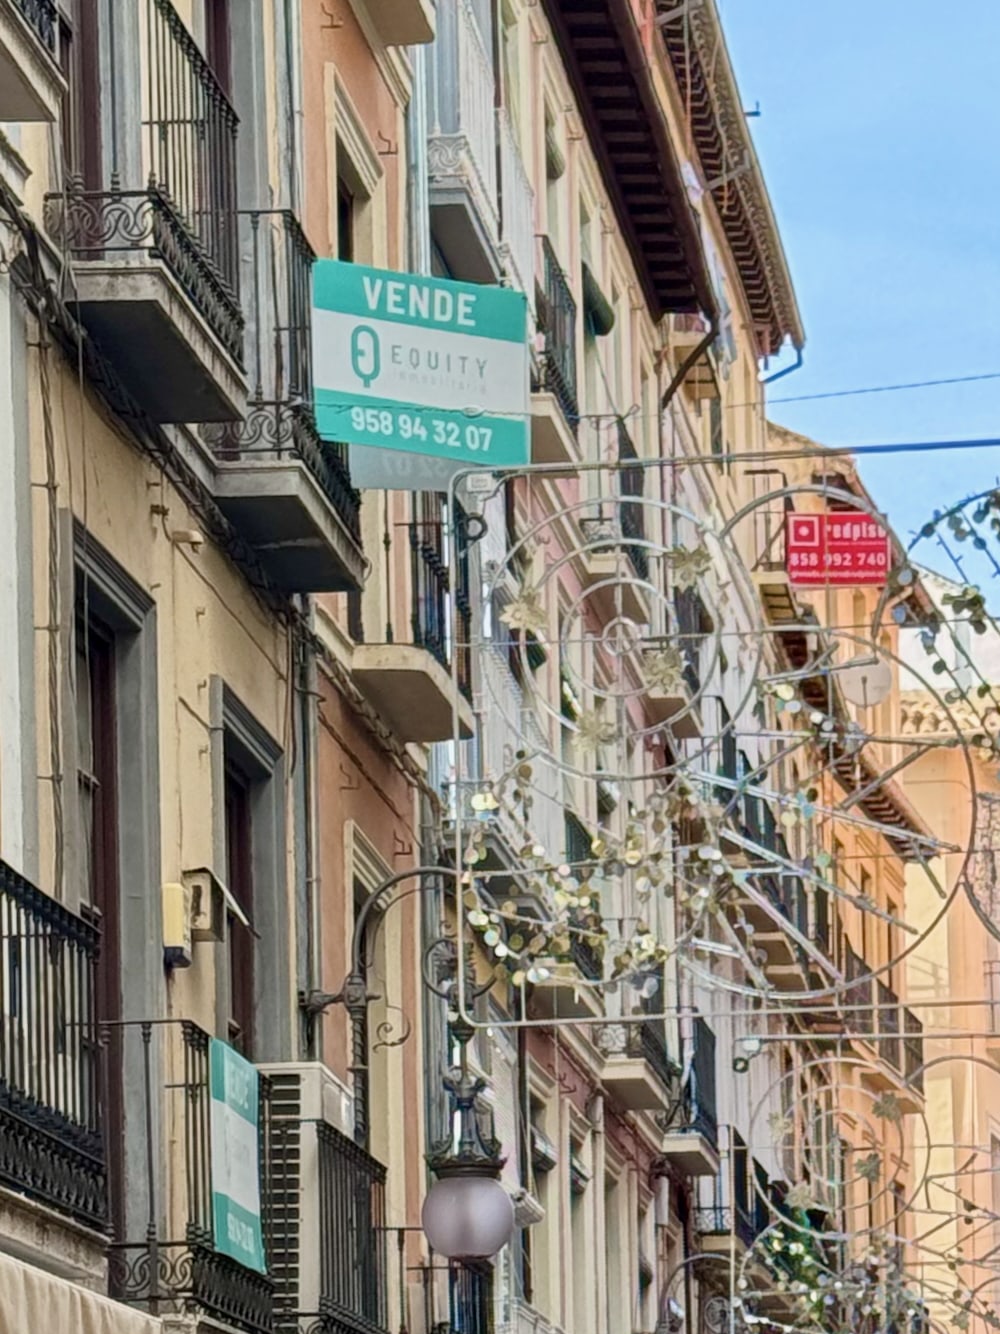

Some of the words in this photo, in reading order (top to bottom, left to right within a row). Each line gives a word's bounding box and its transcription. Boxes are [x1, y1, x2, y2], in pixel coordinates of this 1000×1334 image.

[362, 275, 476, 327] VENDE
[391, 345, 488, 379] EQUITY
[351, 406, 393, 436] 958
[398, 414, 428, 441] 94
[432, 420, 461, 447] 32
[465, 425, 493, 451] 07
[790, 552, 819, 566] 858
[822, 552, 852, 566] 992
[856, 552, 886, 566] 740
